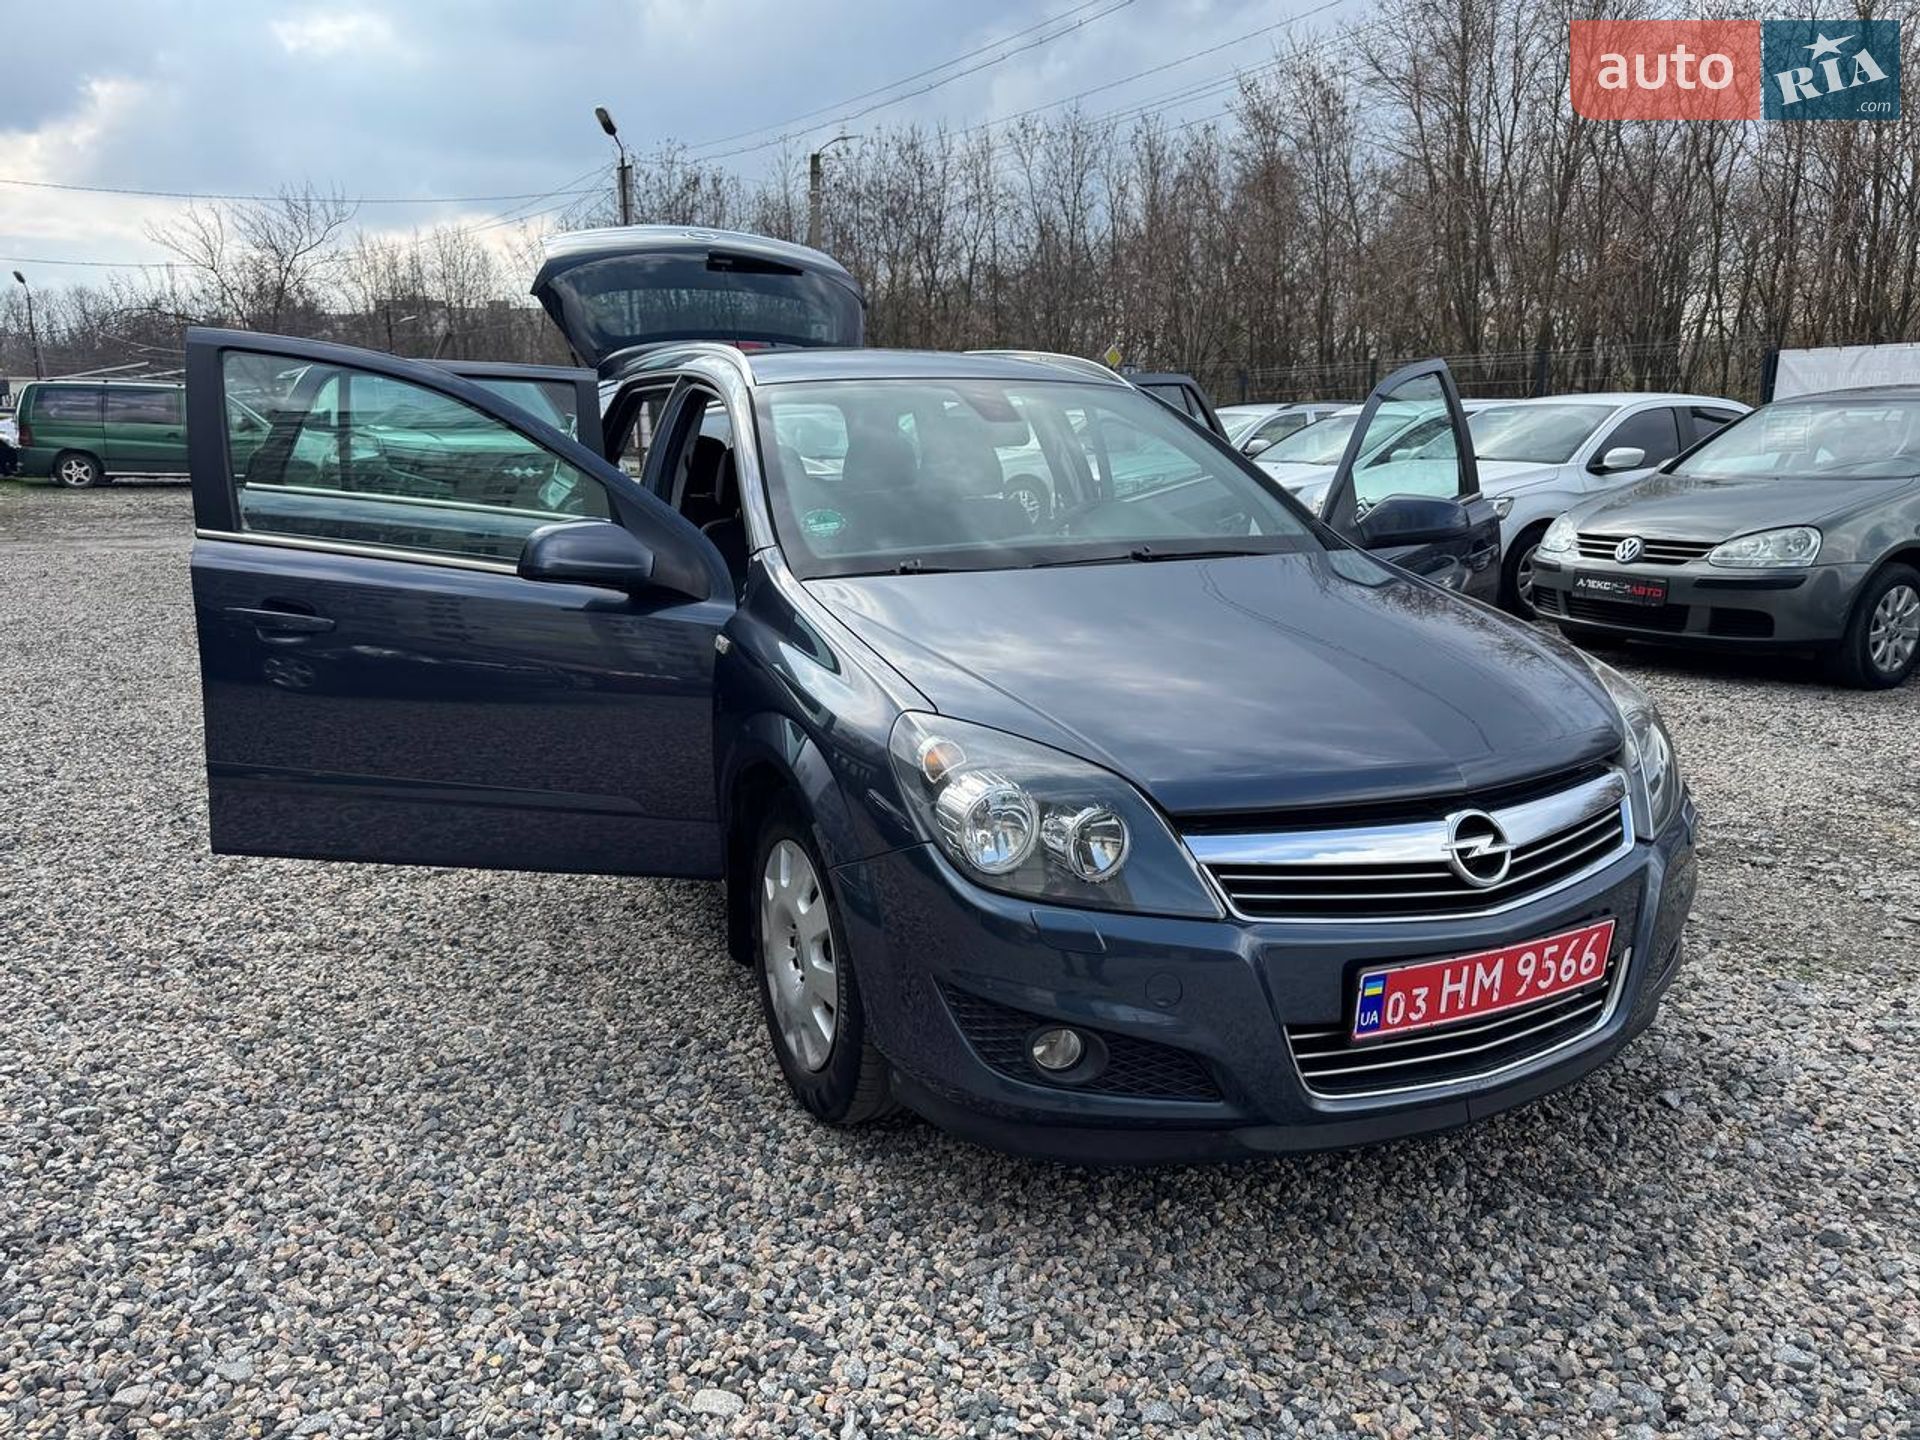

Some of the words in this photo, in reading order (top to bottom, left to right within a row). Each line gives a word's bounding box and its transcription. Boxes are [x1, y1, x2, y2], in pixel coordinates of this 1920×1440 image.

[1359, 1009, 1379, 1026] UA
[1386, 986, 1429, 1025] 03
[1439, 957, 1504, 1014] HM
[1515, 932, 1600, 997] 9566
